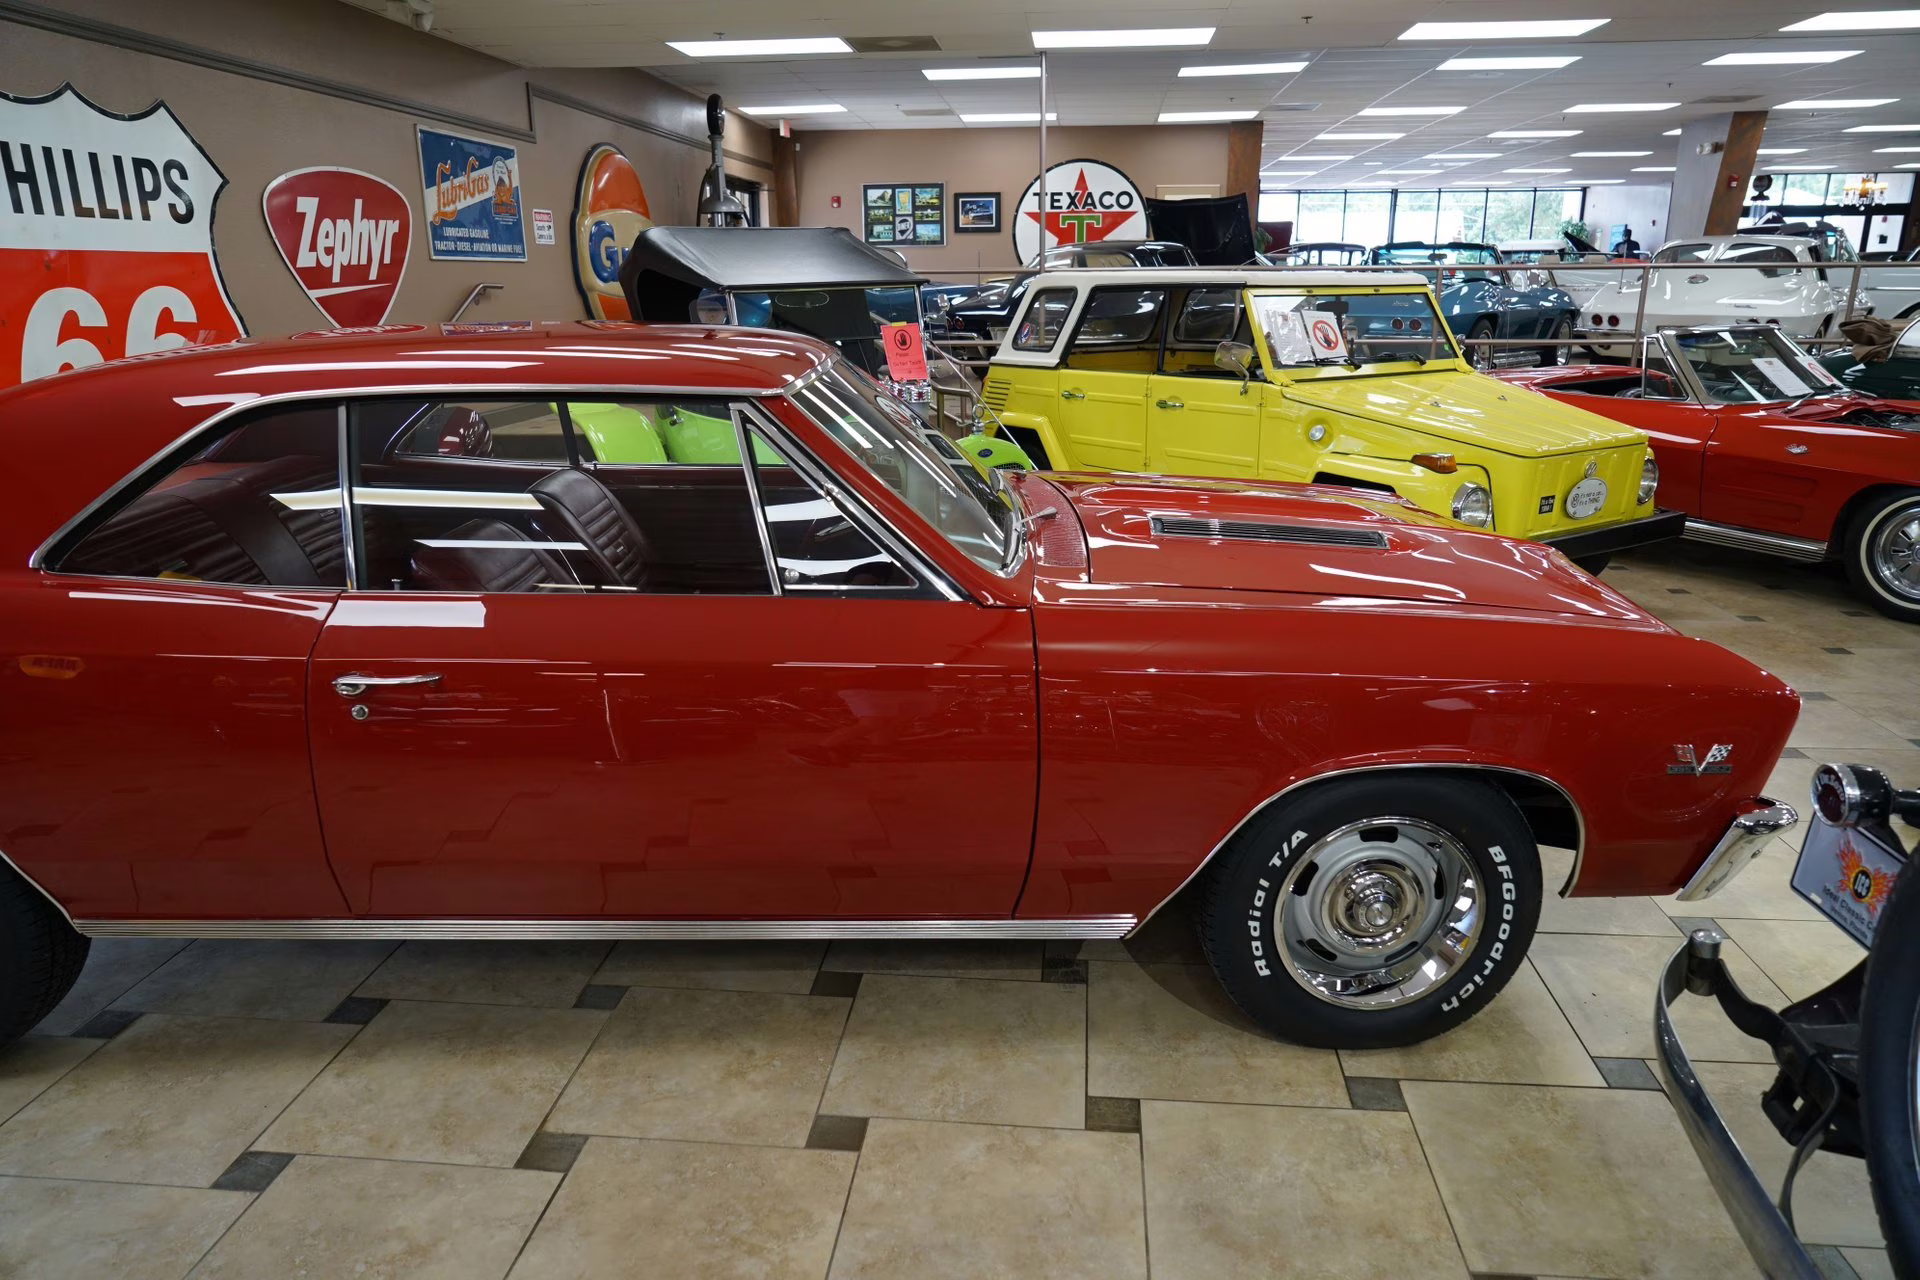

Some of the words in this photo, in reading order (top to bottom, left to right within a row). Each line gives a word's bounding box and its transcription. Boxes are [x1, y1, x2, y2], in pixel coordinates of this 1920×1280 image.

[1032, 190, 1134, 211] TEXACO
[296, 196, 400, 284] Zephyr
[470, 228, 490, 239] GASOLINE
[1059, 213, 1102, 244] T
[473, 242, 491, 252] AVIATION
[1247, 878, 1271, 977] Radial
[1268, 829, 1309, 869] T/A
[1840, 898, 1866, 925] Classic
[1440, 845, 1516, 1013] BFGoodrich
